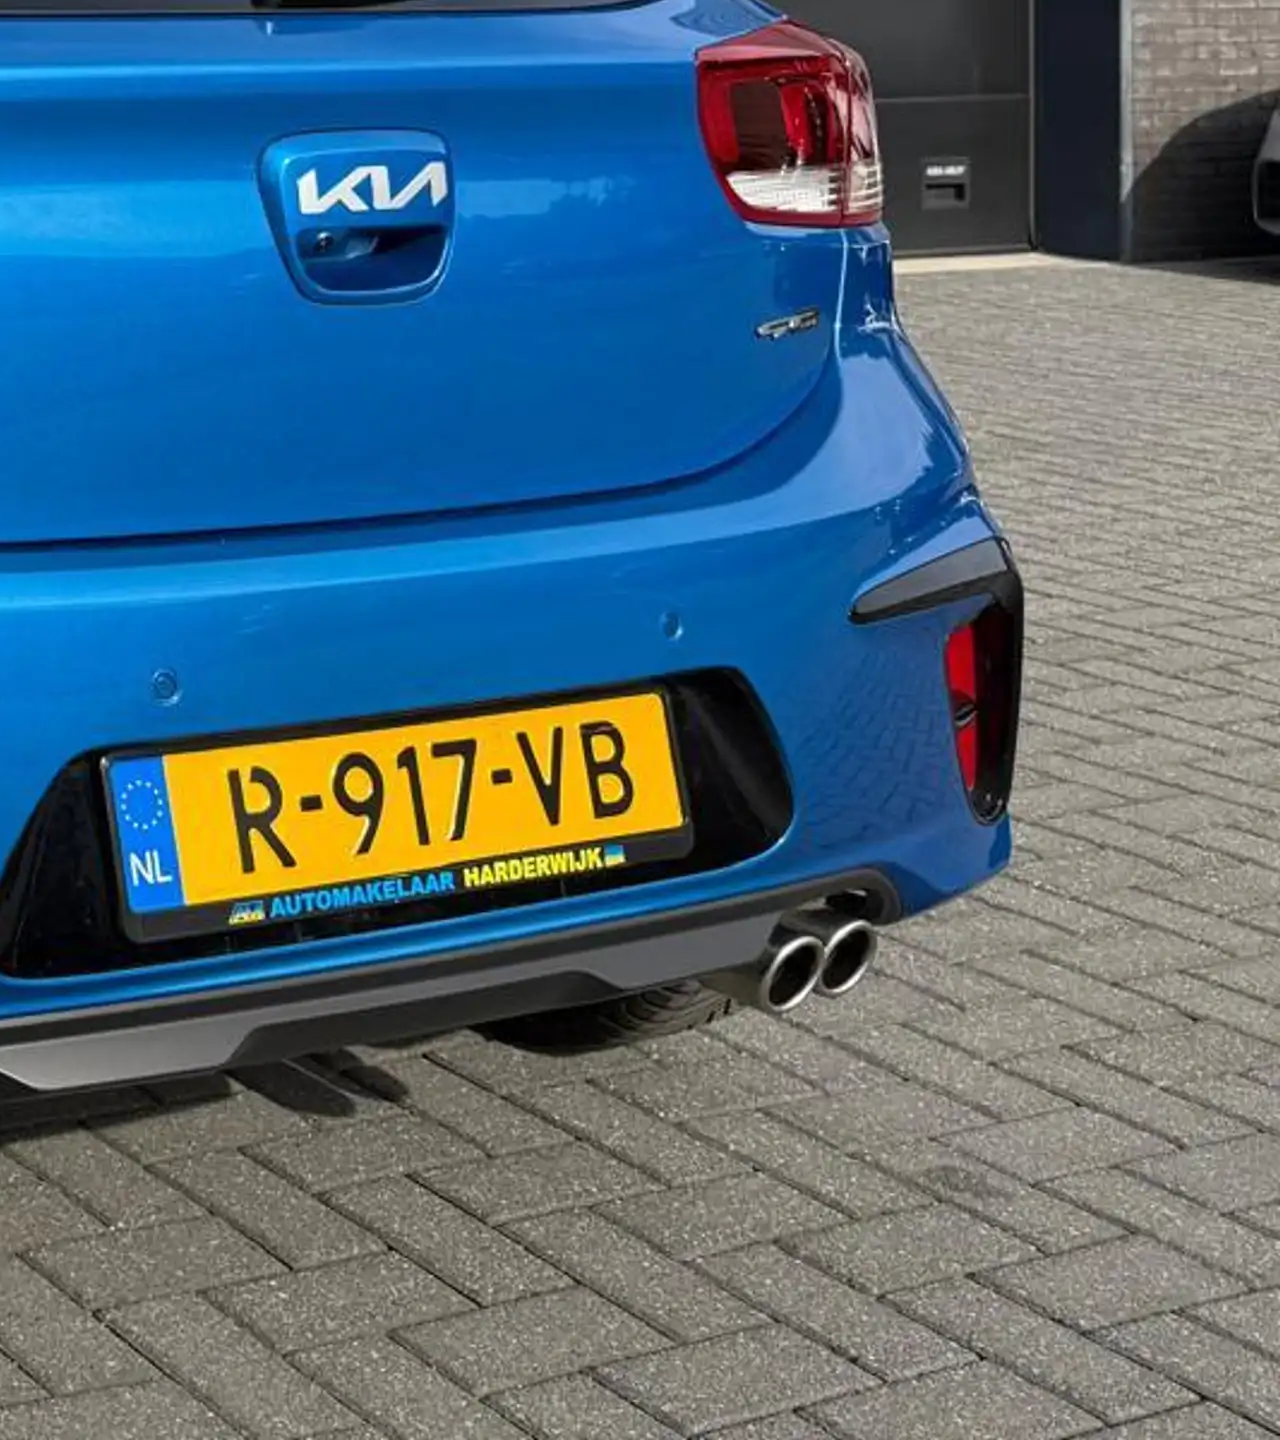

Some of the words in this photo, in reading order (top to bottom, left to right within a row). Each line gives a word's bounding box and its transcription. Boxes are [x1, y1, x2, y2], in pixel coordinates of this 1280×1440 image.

[297, 161, 447, 215] KIA
[227, 720, 635, 874] R-917-VB
[129, 849, 173, 887] NL
[270, 871, 455, 919] AUTOMAKELAAR
[464, 848, 605, 888] HARDERWIJK
